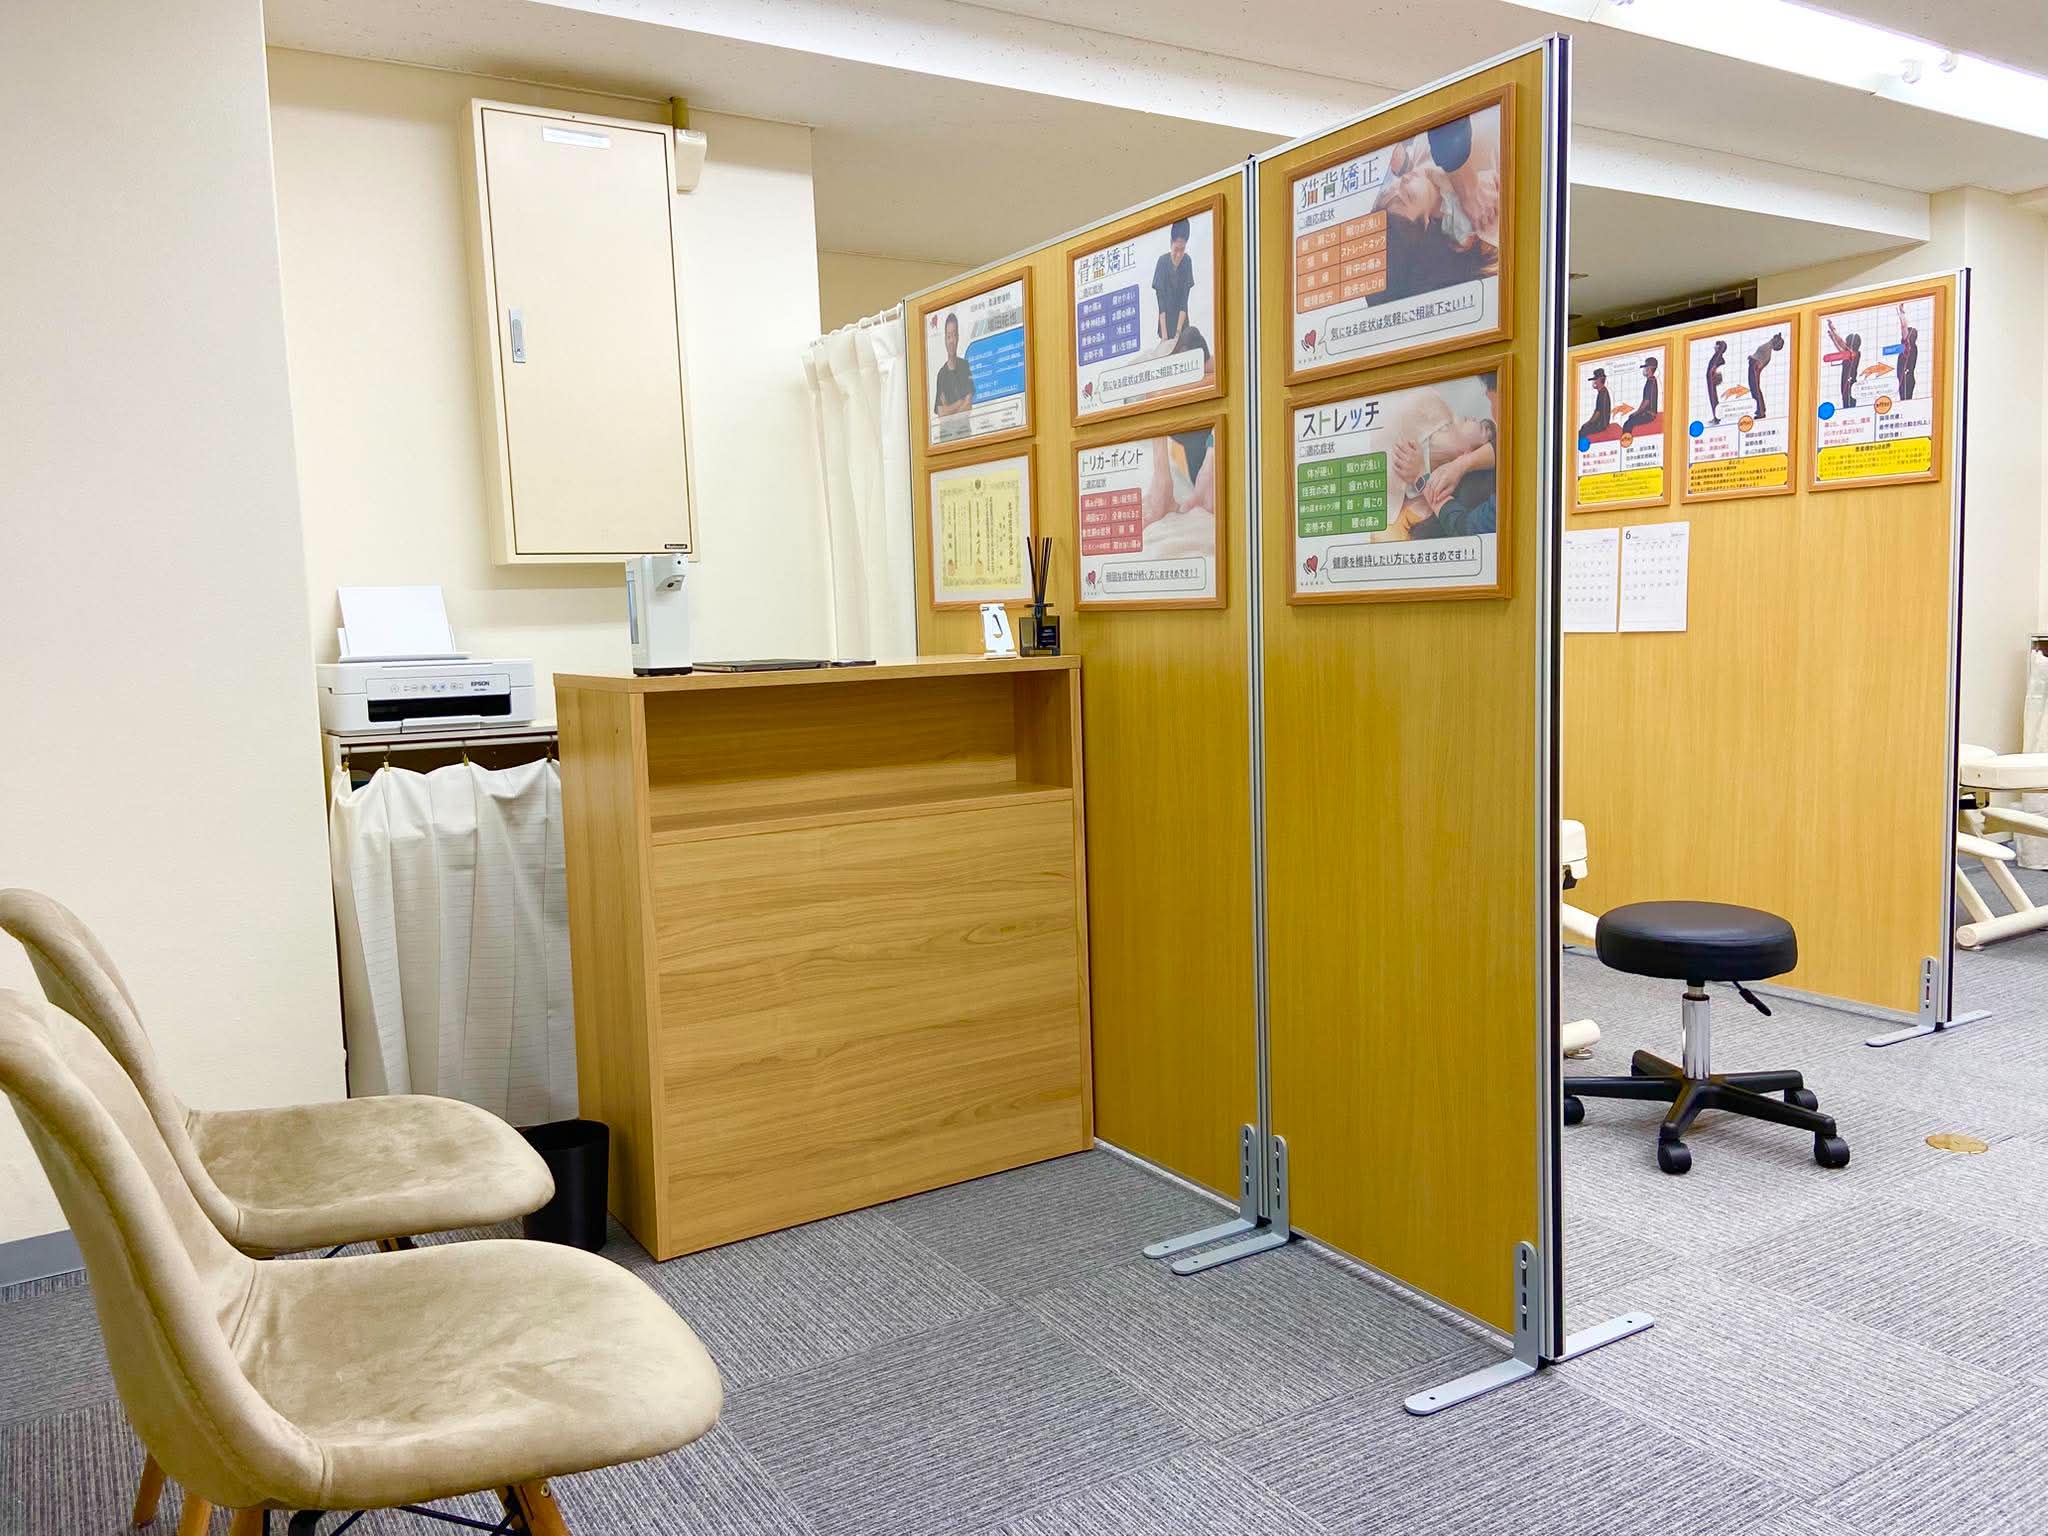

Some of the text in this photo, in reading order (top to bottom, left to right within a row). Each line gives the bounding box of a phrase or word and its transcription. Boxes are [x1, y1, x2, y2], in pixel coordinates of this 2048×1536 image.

[1301, 156, 1379, 208] 猫背矯正
[1079, 243, 1136, 284] 骨盤矯正
[1303, 401, 1379, 438] ストレッチ
[1082, 448, 1143, 472] トリガーポイント
[1625, 530, 1632, 540] 6
